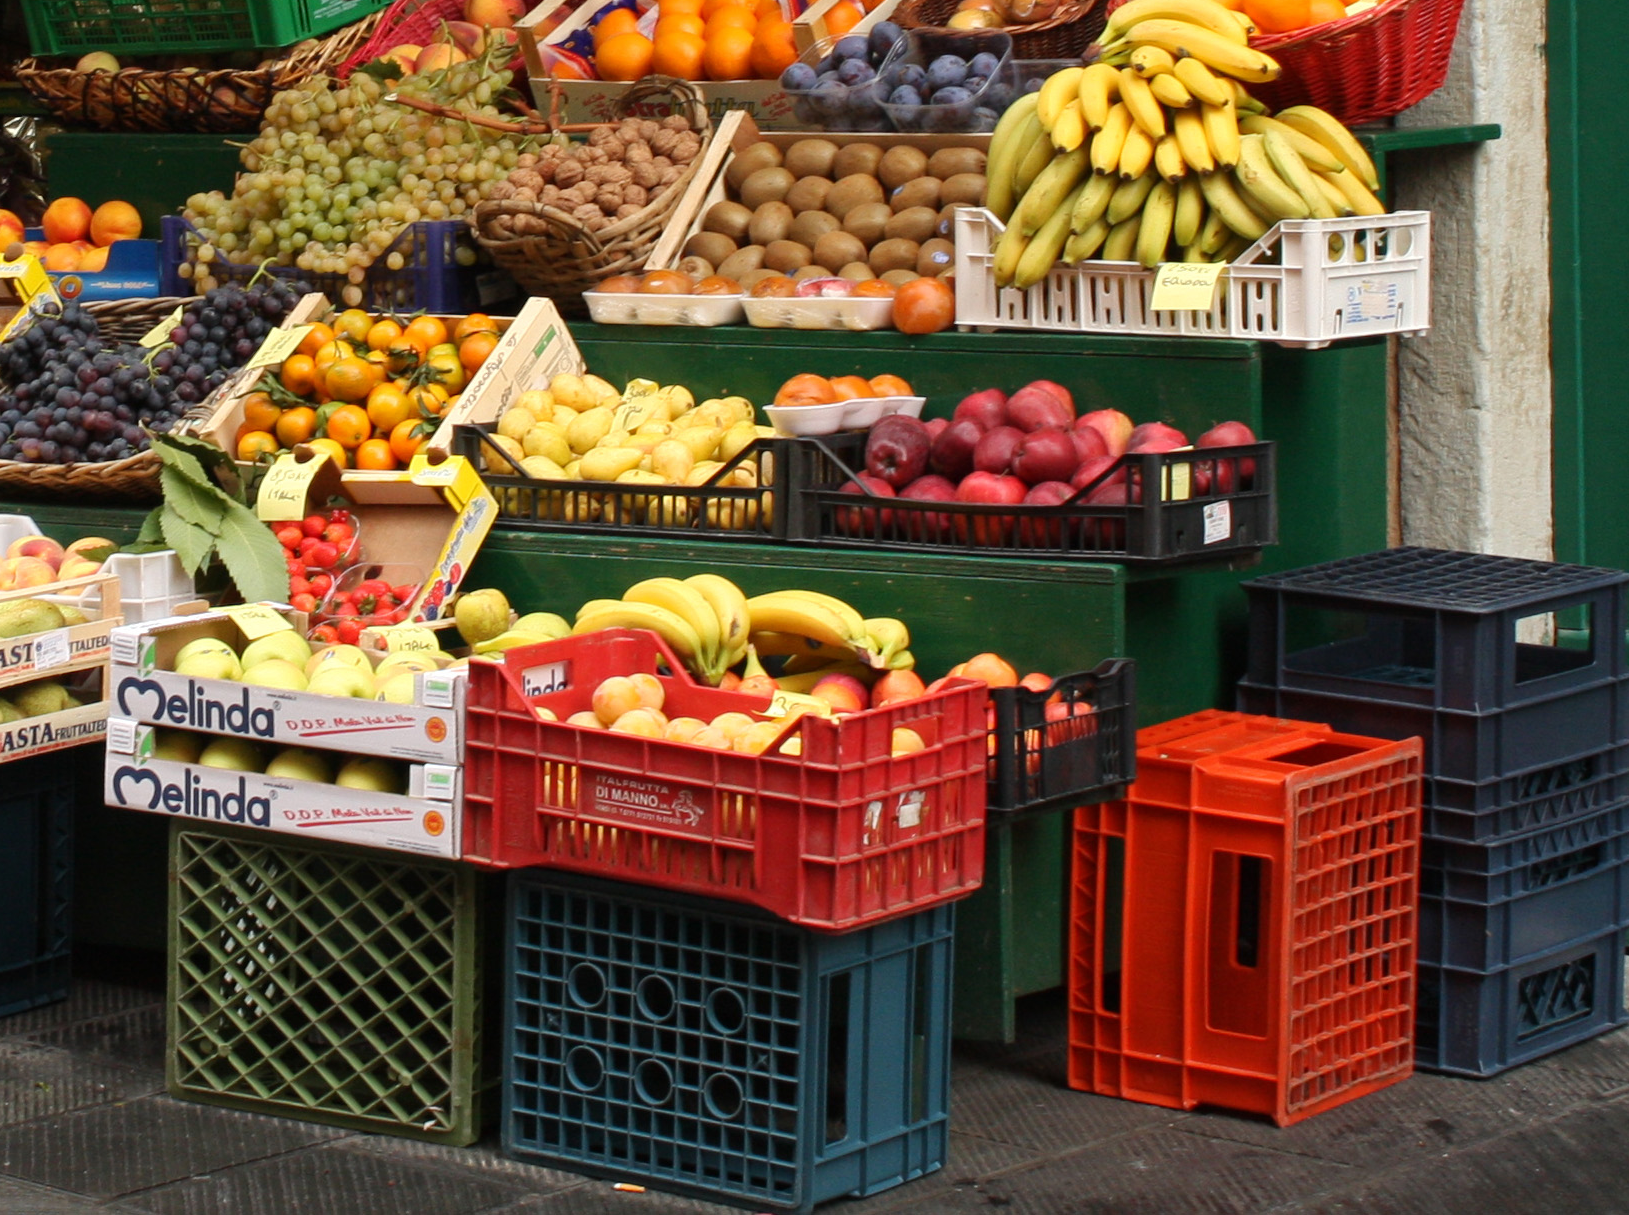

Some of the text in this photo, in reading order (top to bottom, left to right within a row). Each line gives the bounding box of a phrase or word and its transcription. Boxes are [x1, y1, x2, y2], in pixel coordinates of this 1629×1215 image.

[117, 676, 275, 738] Melinda
[362, 715, 384, 725] Val
[385, 716, 394, 724] di
[395, 714, 416, 723] Non
[1, 722, 55, 753] ASTA
[55, 719, 108, 740] FRUTTALTED
[596, 774, 669, 794] ITALFRUTTA
[113, 766, 271, 828] Melinda
[595, 785, 608, 798] DI
[611, 788, 658, 807] MANNO
[360, 807, 382, 817] Val
[383, 807, 392, 816] di
[393, 806, 414, 816] Non
